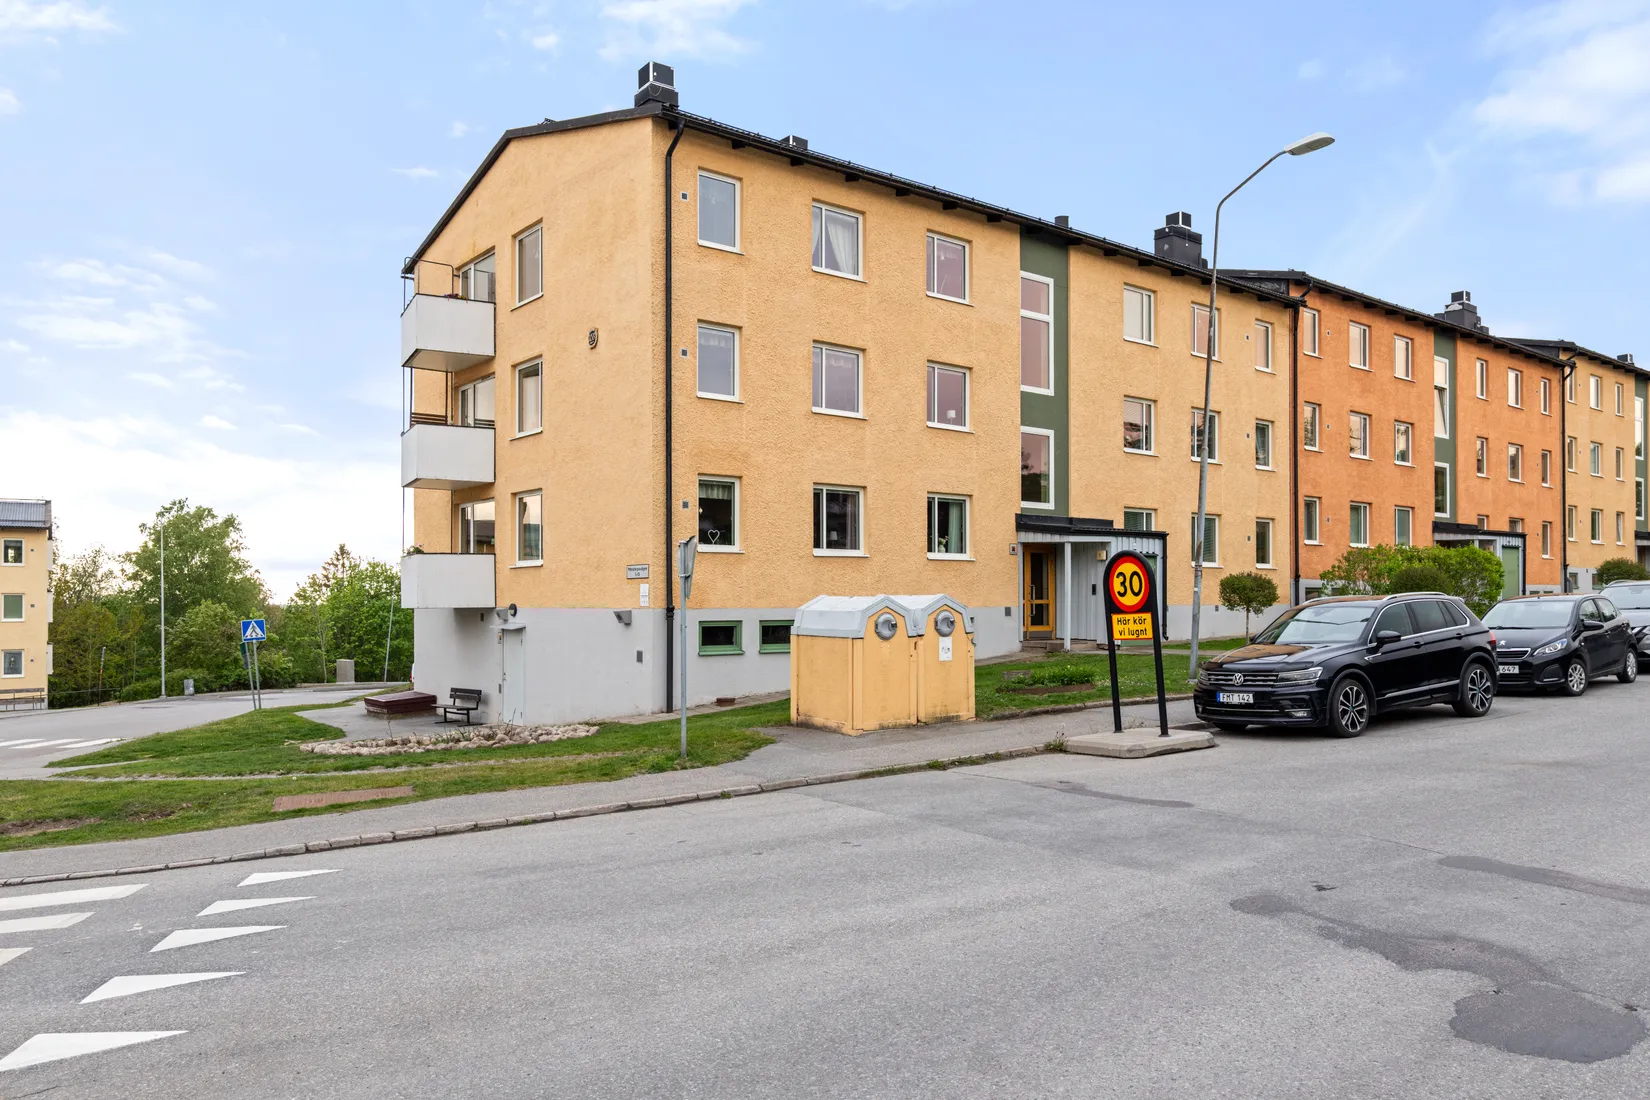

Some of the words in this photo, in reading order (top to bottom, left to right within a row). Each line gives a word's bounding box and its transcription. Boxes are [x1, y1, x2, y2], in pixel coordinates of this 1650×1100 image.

[1116, 570, 1142, 597] 30
[1117, 617, 1130, 625] Här
[1133, 616, 1147, 625] kör
[1118, 628, 1126, 637] vi
[1128, 628, 1147, 637] lugnt
[1222, 693, 1235, 702] FMT
[1237, 694, 1251, 702] 142
